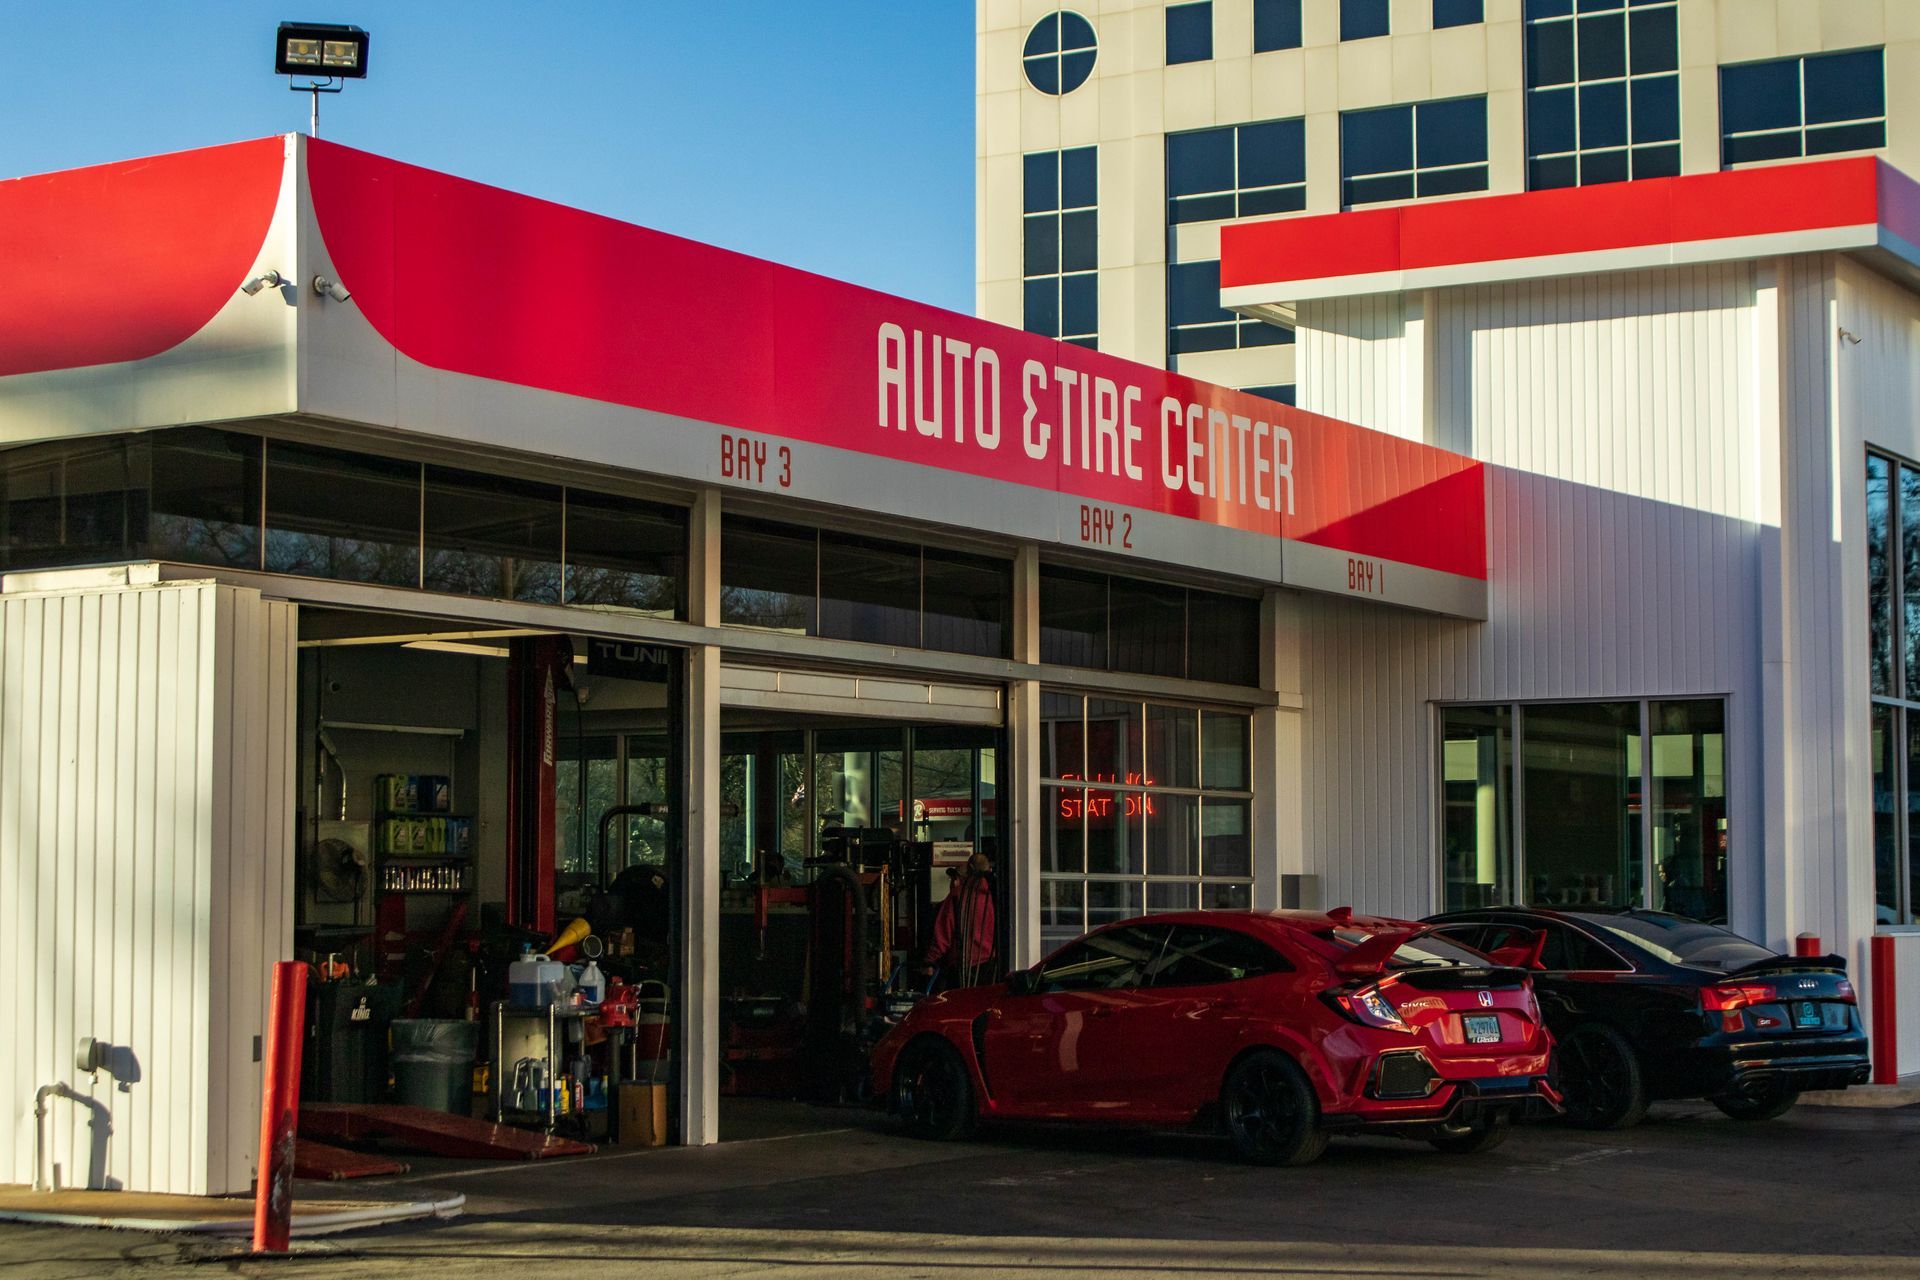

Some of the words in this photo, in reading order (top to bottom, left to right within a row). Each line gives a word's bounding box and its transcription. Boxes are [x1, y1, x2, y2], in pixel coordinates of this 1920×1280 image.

[878, 322, 1000, 450] AUTO
[1160, 396, 1295, 516] CENTER
[721, 434, 766, 483] BAY
[779, 446, 791, 487] 3
[1080, 505, 1114, 546] BAY
[1122, 513, 1133, 549] 2
[1348, 558, 1373, 593] BAY
[1061, 796, 1153, 818] STATON
